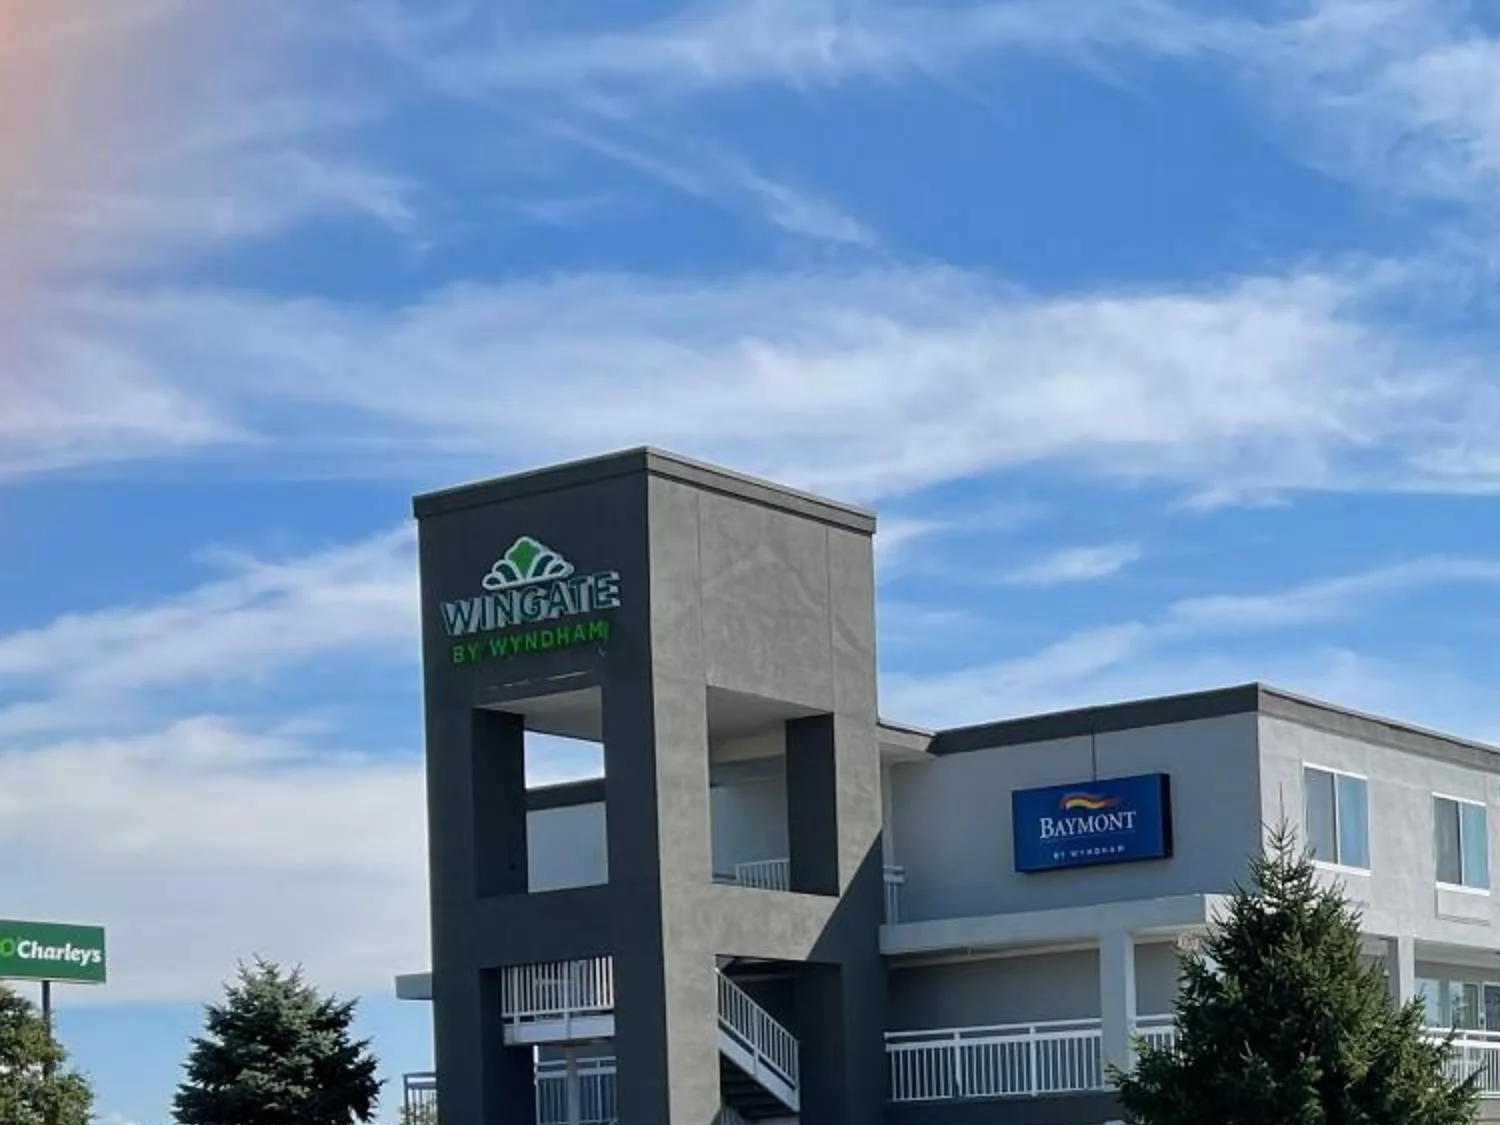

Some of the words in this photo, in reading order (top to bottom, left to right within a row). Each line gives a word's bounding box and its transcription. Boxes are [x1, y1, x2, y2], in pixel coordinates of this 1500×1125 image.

[440, 571, 621, 636] WINGATE
[453, 641, 479, 664] BY
[489, 621, 609, 657] WYNDHAM
[1039, 810, 1137, 839] BAYMONT
